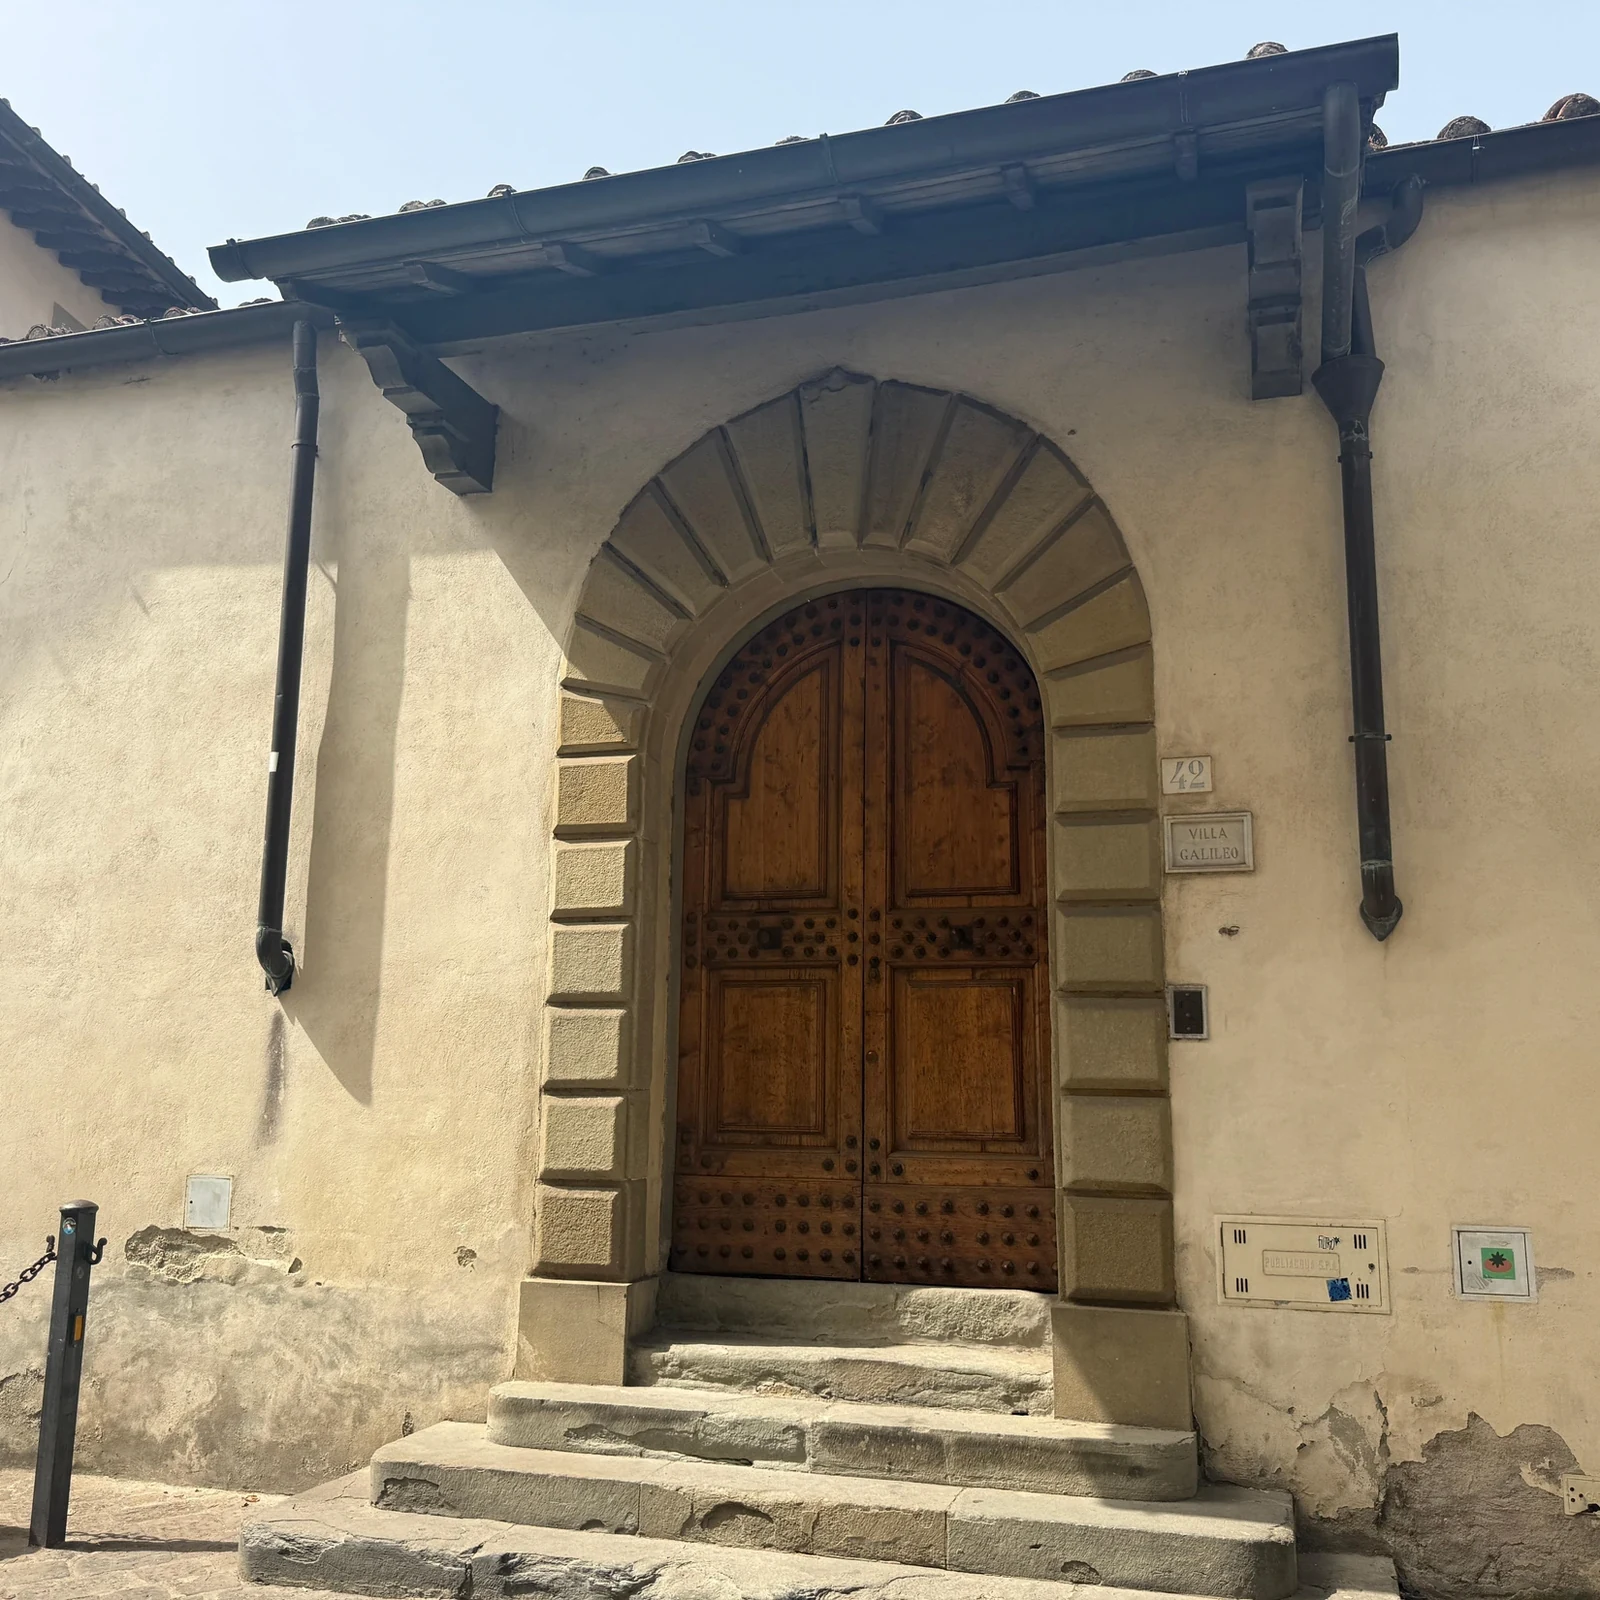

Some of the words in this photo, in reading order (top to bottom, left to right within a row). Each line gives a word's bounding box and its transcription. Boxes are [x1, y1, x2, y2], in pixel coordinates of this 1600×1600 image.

[1169, 760, 1205, 790] 42
[1188, 827, 1228, 840] VILLA
[1180, 847, 1239, 861] GALILEO
